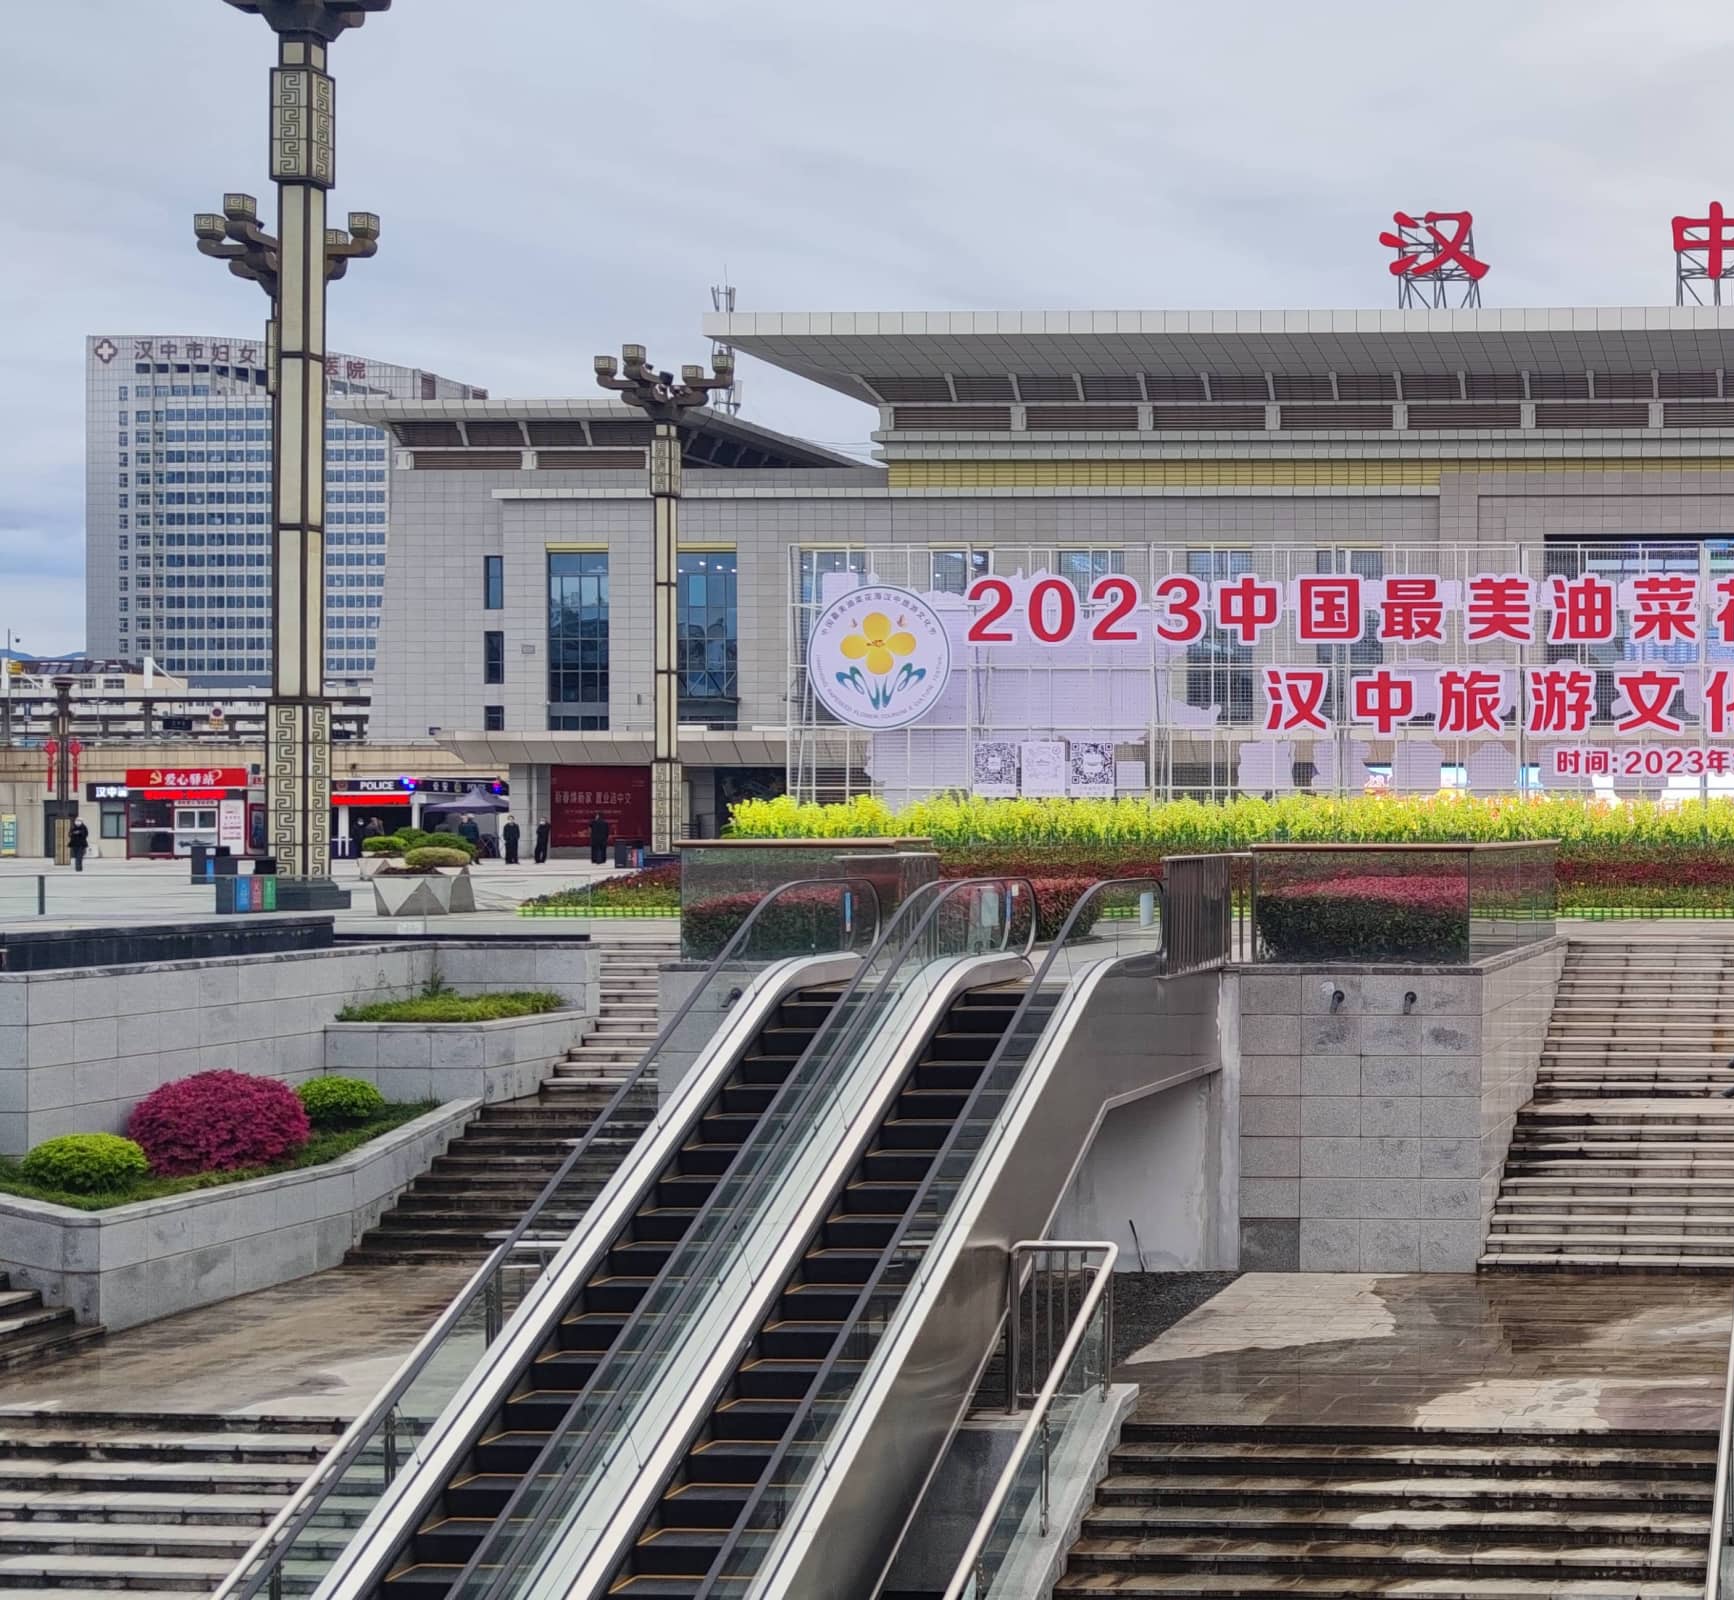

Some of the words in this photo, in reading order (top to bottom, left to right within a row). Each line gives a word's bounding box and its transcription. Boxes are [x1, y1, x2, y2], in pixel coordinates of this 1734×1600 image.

[134, 340, 367, 380] 汉中市妇女医院
[360, 781, 394, 791] POLICE
